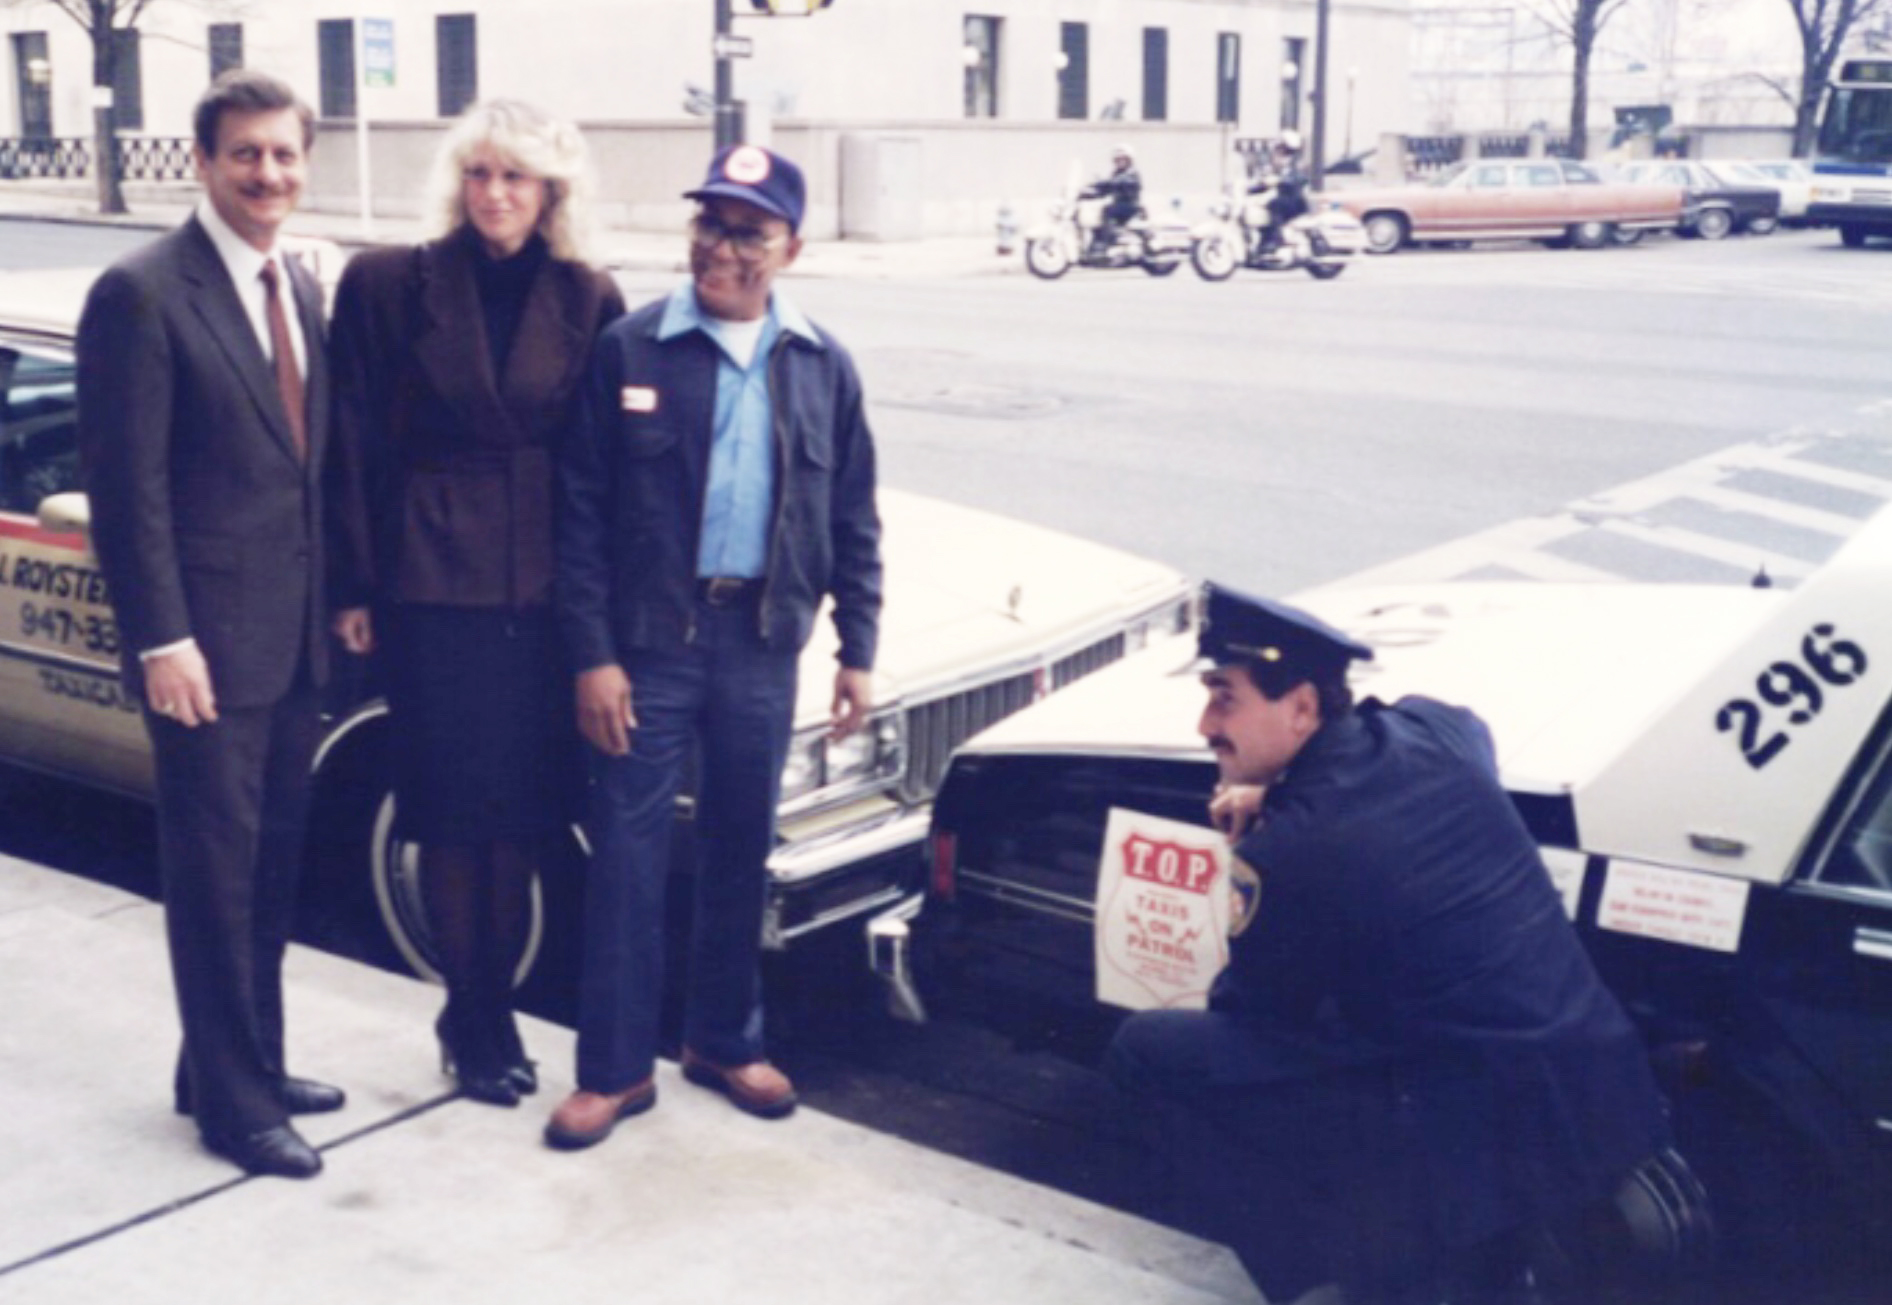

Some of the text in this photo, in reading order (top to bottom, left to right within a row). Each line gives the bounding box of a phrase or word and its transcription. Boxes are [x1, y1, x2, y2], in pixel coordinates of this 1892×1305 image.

[13, 557, 107, 604] ROYSTE
[1715, 622, 1868, 770] 296
[1136, 894, 1189, 922] TAXIS
[1147, 919, 1173, 937] ON
[1126, 932, 1196, 963] PATROL
